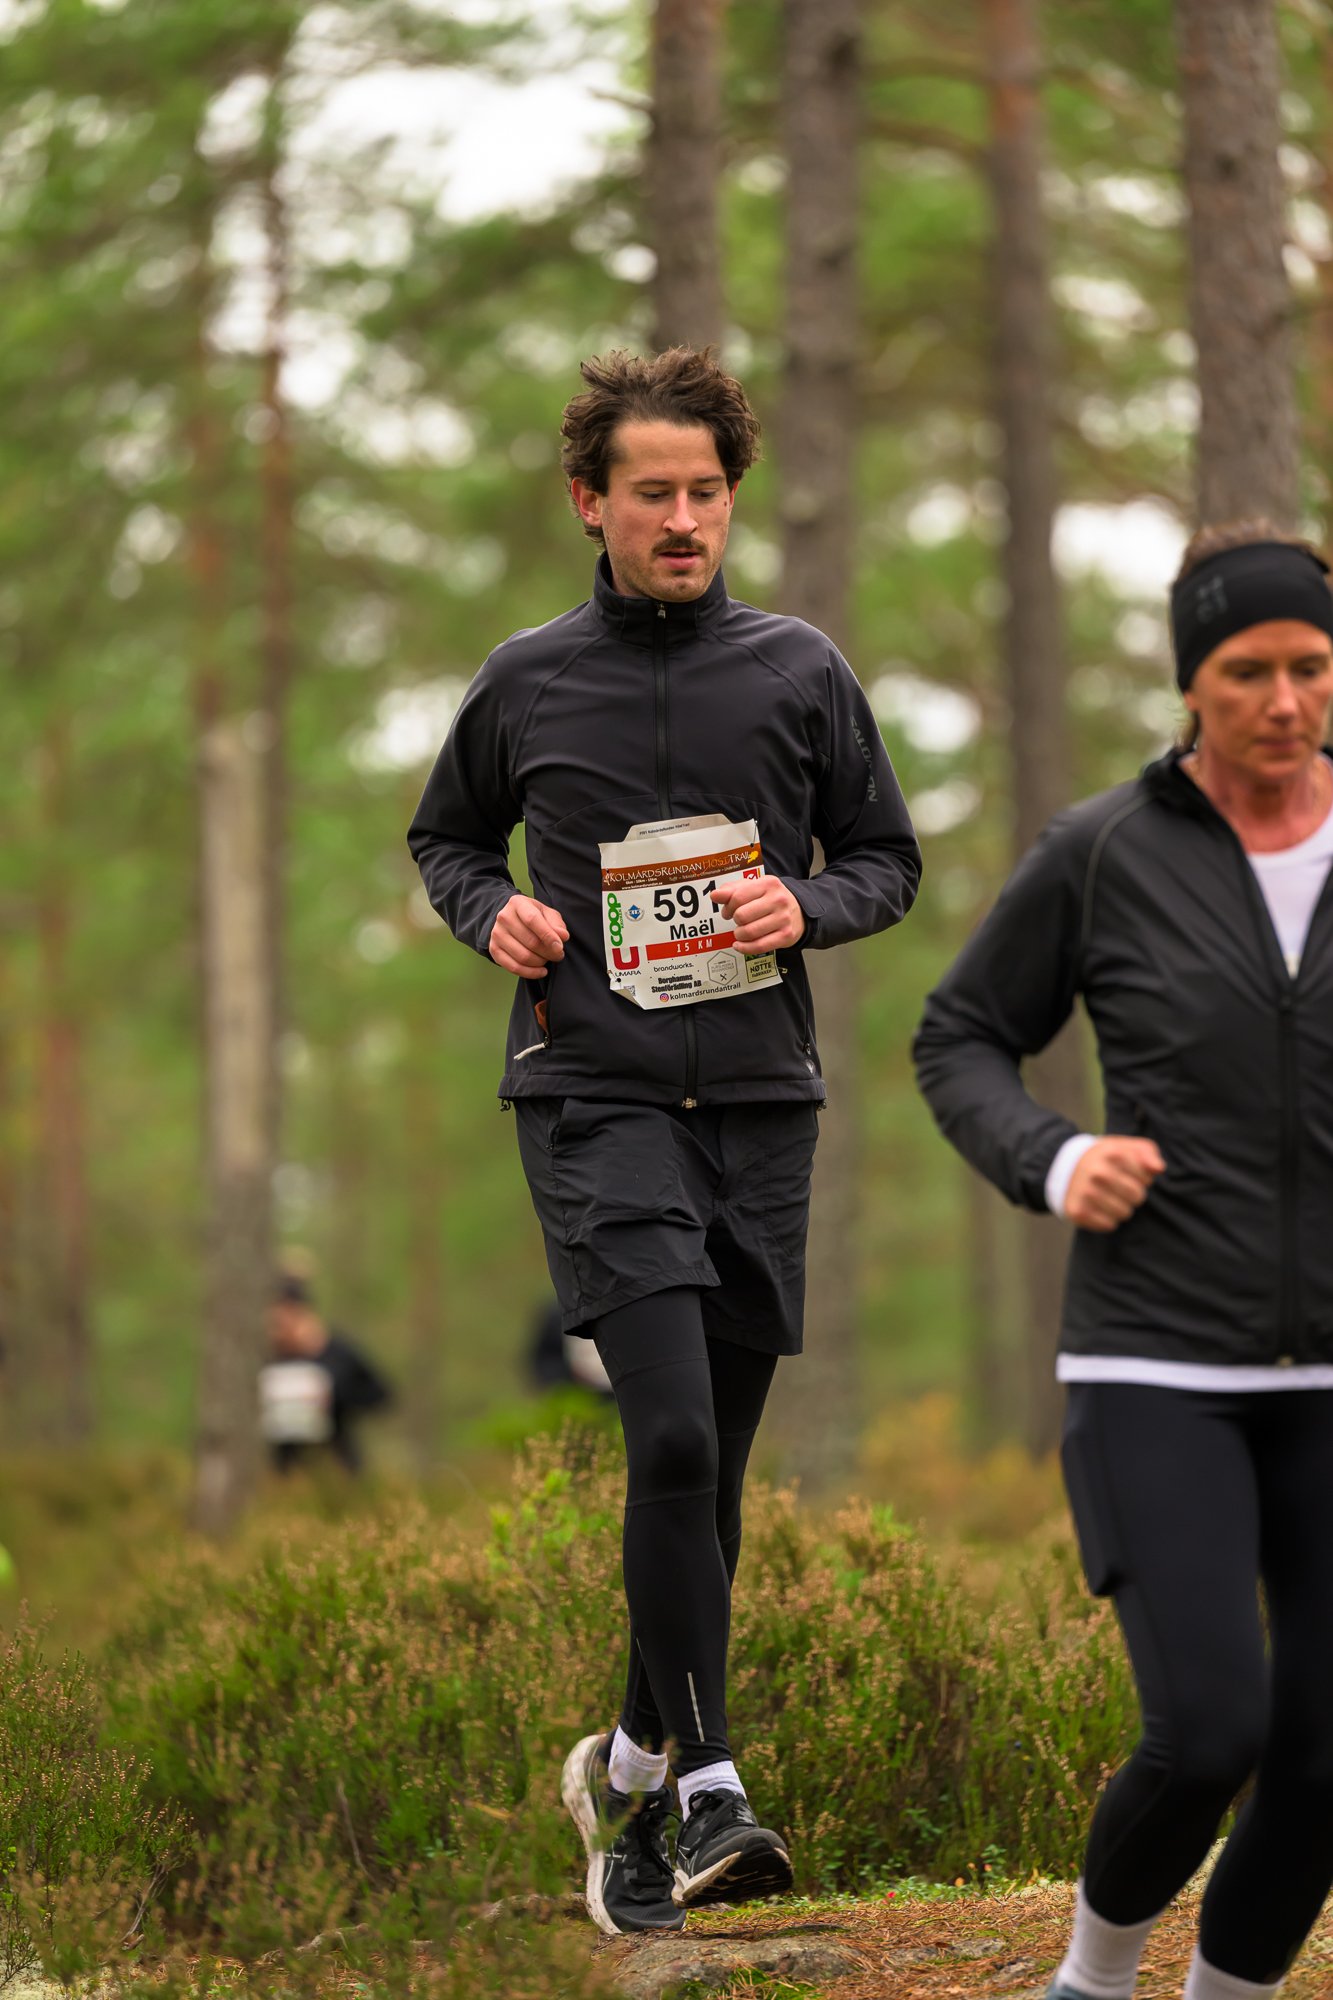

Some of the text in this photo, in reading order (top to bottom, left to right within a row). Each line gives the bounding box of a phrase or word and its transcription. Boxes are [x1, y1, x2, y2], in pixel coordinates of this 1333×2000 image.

[653, 880, 720, 922] 591
[670, 918, 715, 941] Maël
[676, 938, 713, 953] 15 KM
[670, 983, 741, 1000] kolmardsrundantrail
